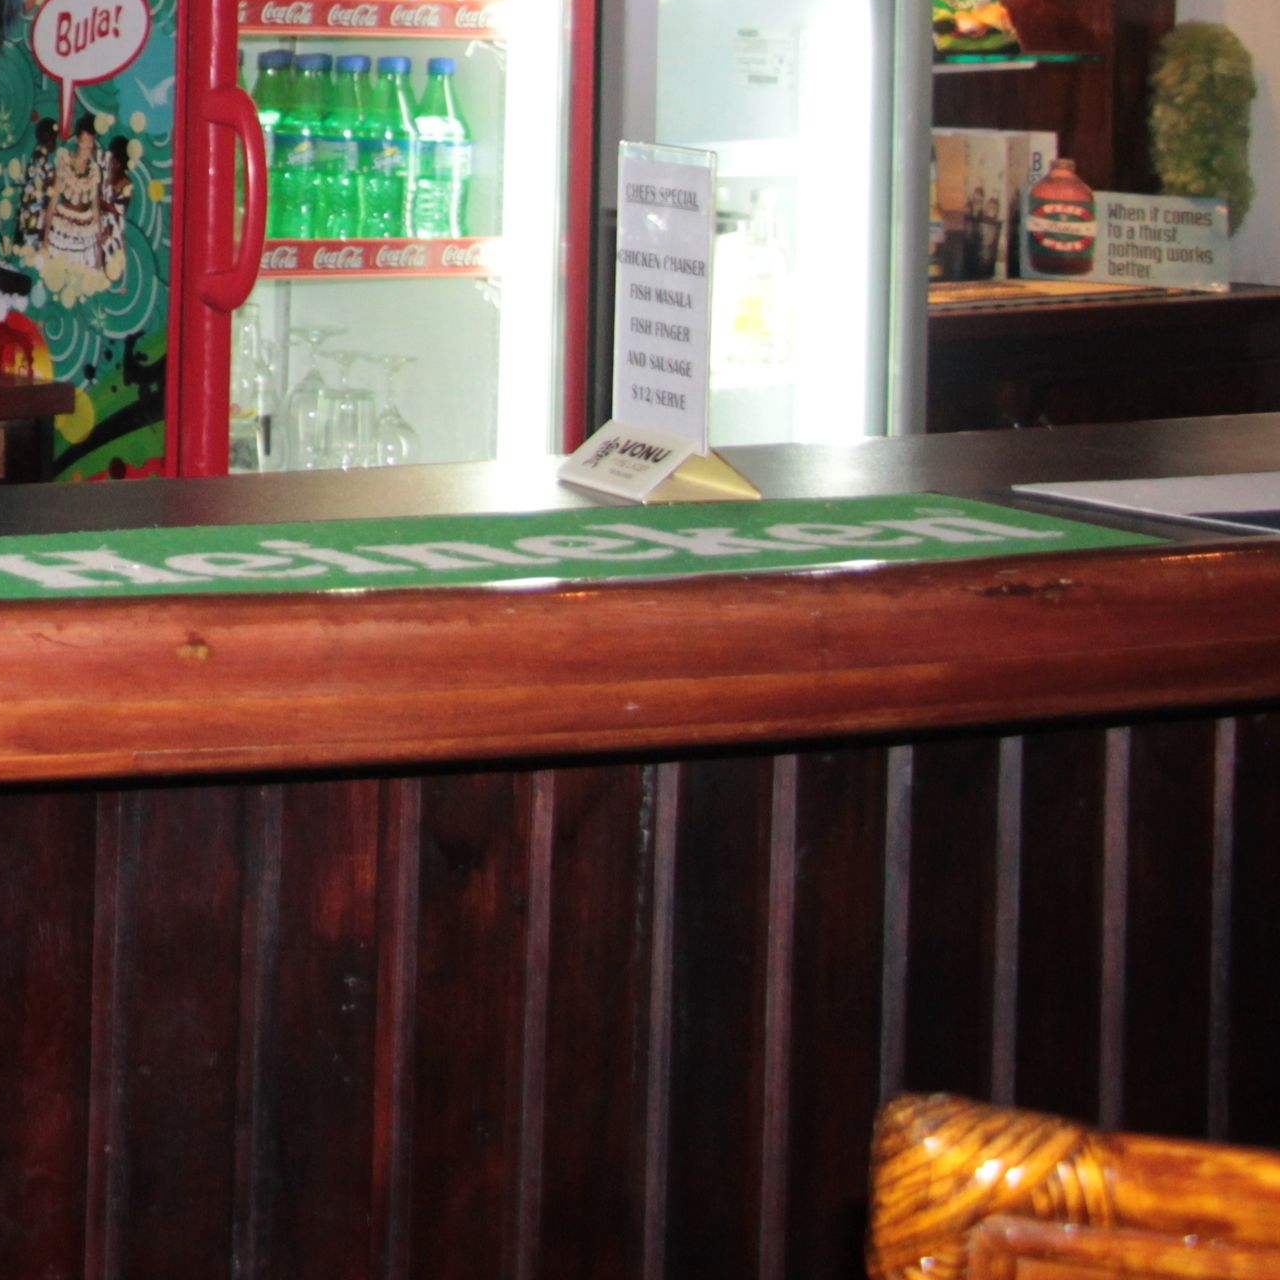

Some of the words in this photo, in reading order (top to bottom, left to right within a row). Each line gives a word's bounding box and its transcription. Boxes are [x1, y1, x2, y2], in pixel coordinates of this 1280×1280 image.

[53, 4, 125, 57] Bula!
[1107, 203, 1146, 221] When
[1164, 208, 1213, 226] comes
[1107, 243, 1162, 264] nothing
[1166, 247, 1214, 265] works
[630, 284, 652, 302] FISH
[630, 316, 653, 335] FISH
[654, 321, 691, 342] FINGER
[649, 355, 693, 378] SAUSAGE
[617, 439, 671, 463] VONU
